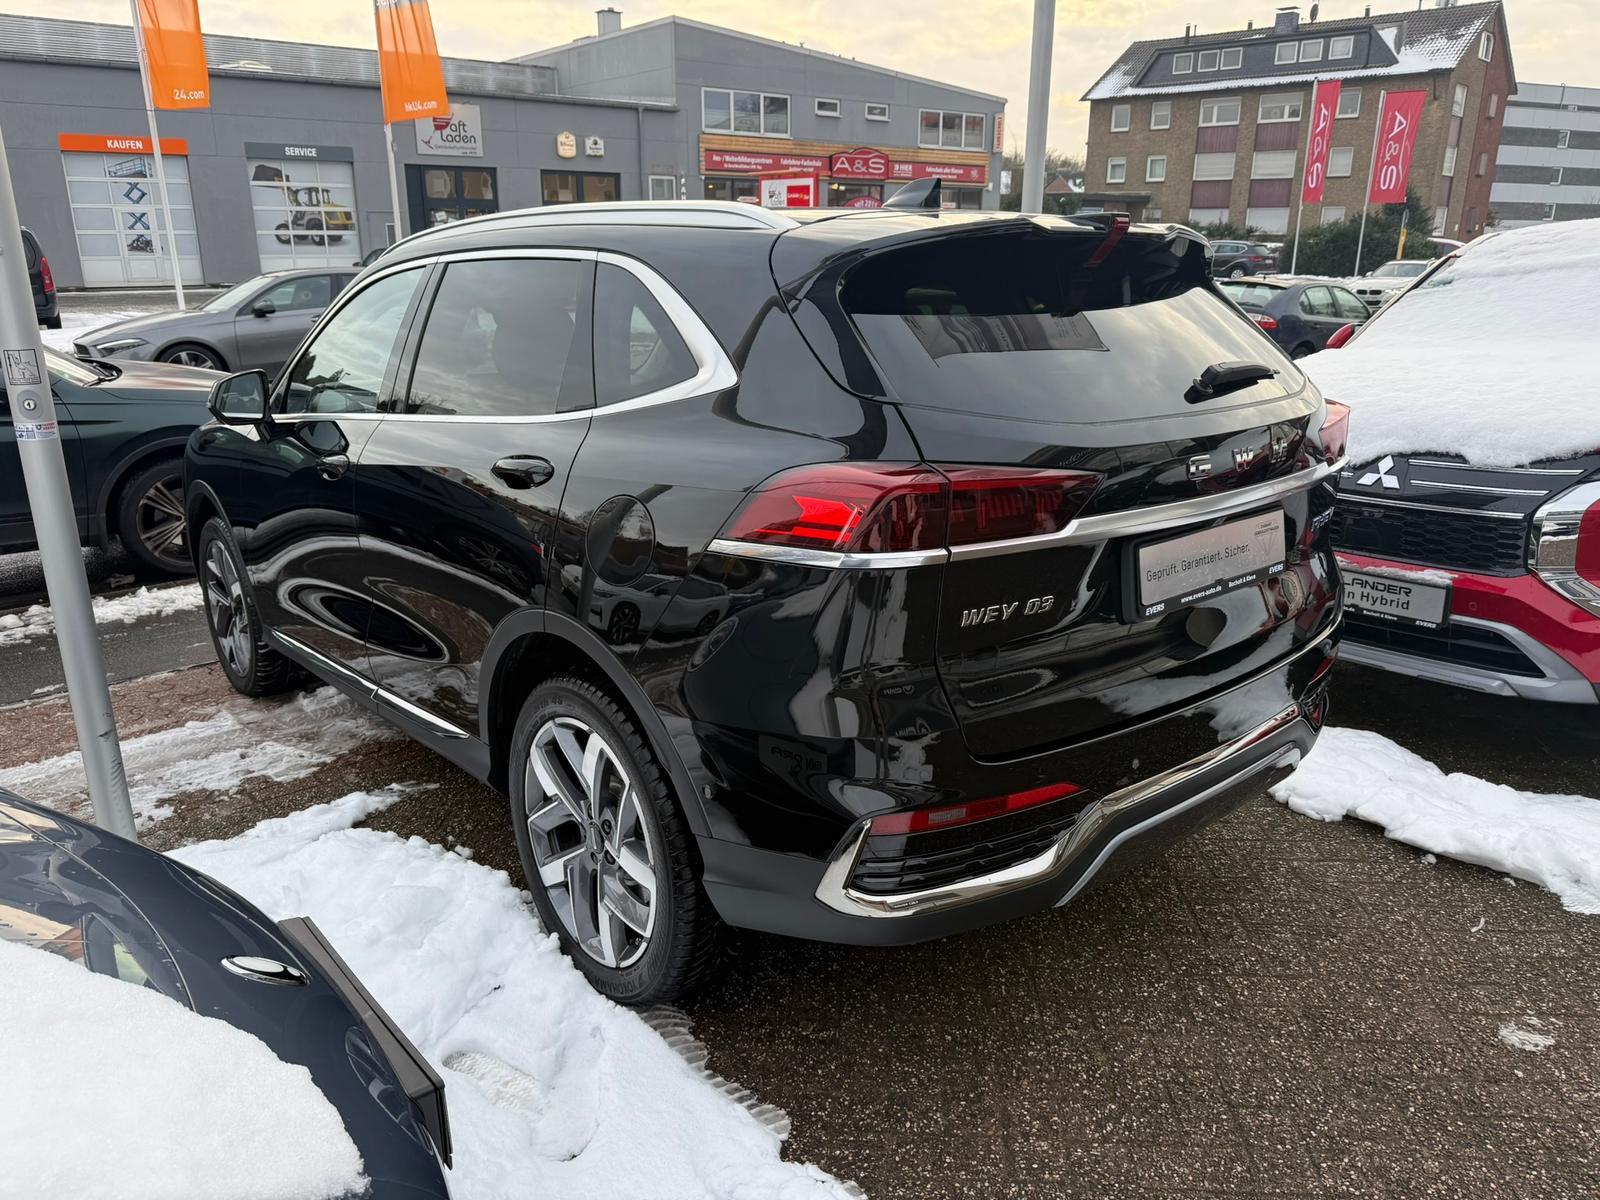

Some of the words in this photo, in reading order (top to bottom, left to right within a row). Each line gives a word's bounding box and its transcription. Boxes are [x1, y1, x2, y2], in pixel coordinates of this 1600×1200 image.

[173, 89, 205, 100] 24.com
[106, 139, 144, 150] KAUFEN
[284, 146, 318, 158] SERVICE
[1380, 110, 1407, 190] A&S
[833, 156, 886, 174] A&S
[1146, 562, 1180, 582] Geprüft.
[1181, 552, 1223, 571] Garantiert.
[1224, 543, 1250, 559] Sicher.
[1145, 602, 1165, 616] EVERS
[1180, 585, 1222, 603] www.evers-auto.de
[1268, 563, 1284, 574] EVERS
[1360, 591, 1410, 610] Hybrid
[961, 601, 1019, 627] WEY
[1415, 620, 1437, 629] EVERS
